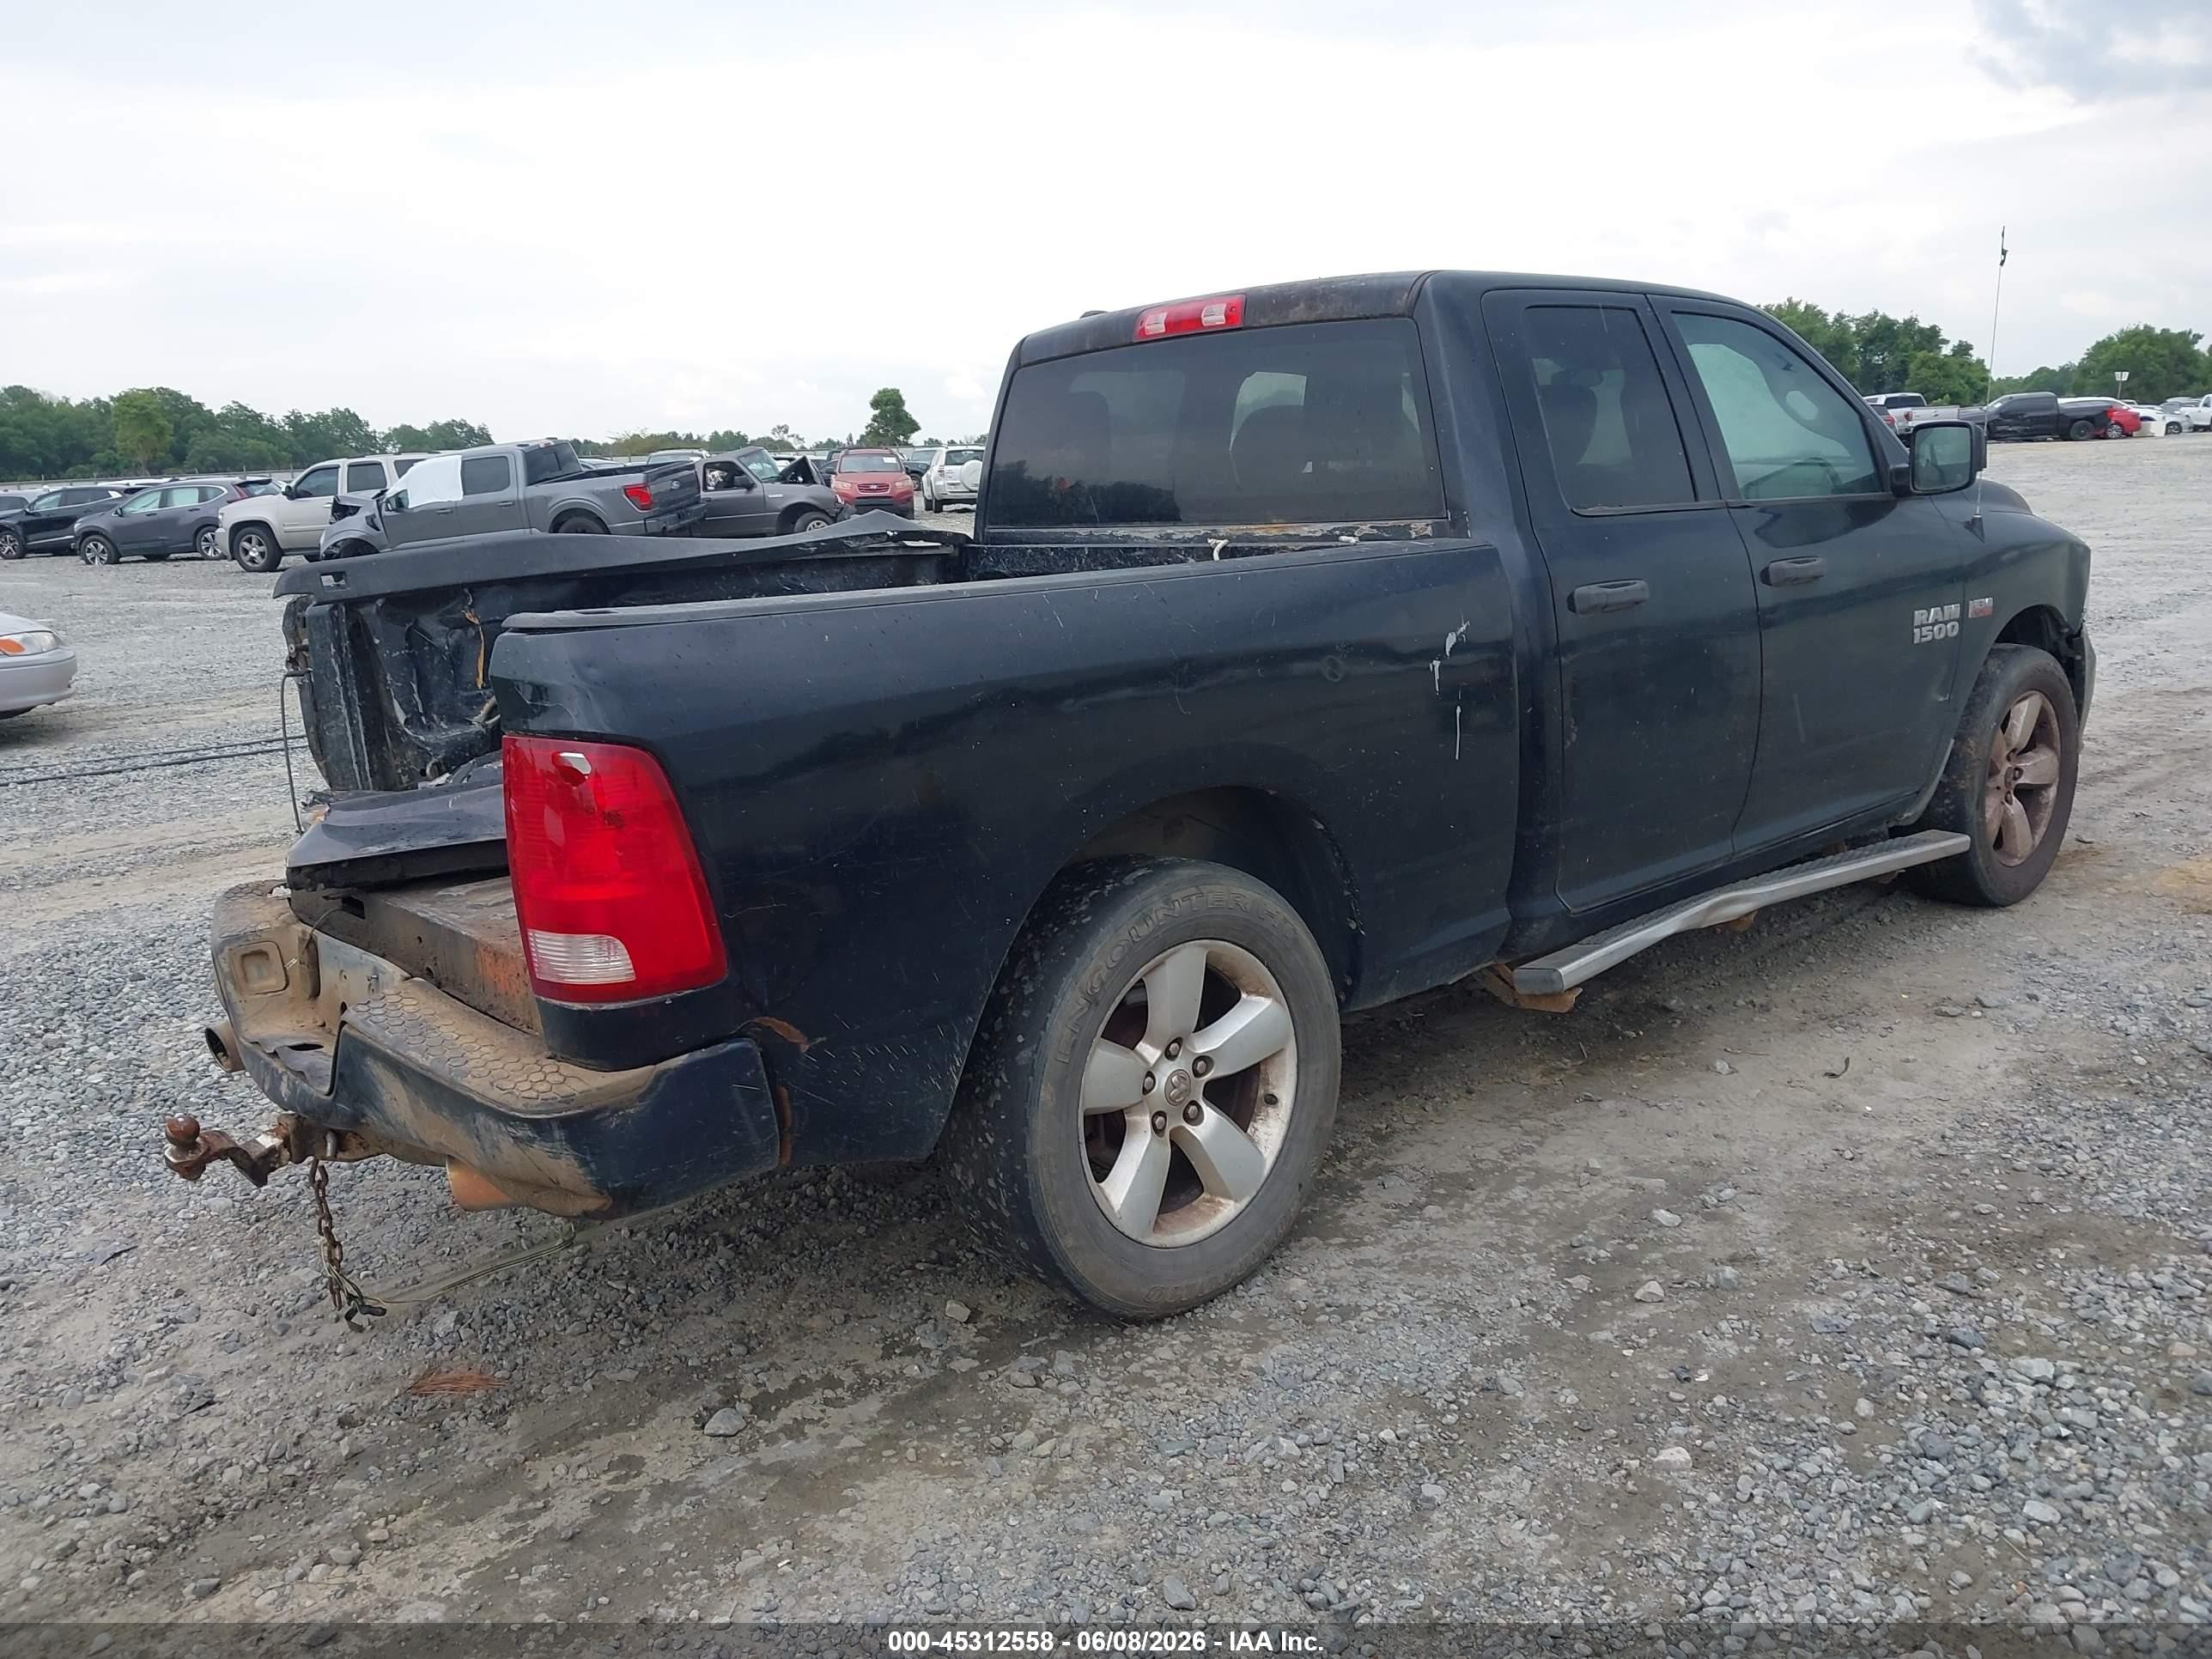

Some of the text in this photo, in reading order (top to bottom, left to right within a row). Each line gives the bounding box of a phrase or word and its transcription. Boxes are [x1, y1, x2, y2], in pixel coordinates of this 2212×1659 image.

[1913, 604, 1961, 626] RAM
[1913, 621, 1960, 644] 1500
[1055, 891, 1249, 1065] ENCOUNTER
